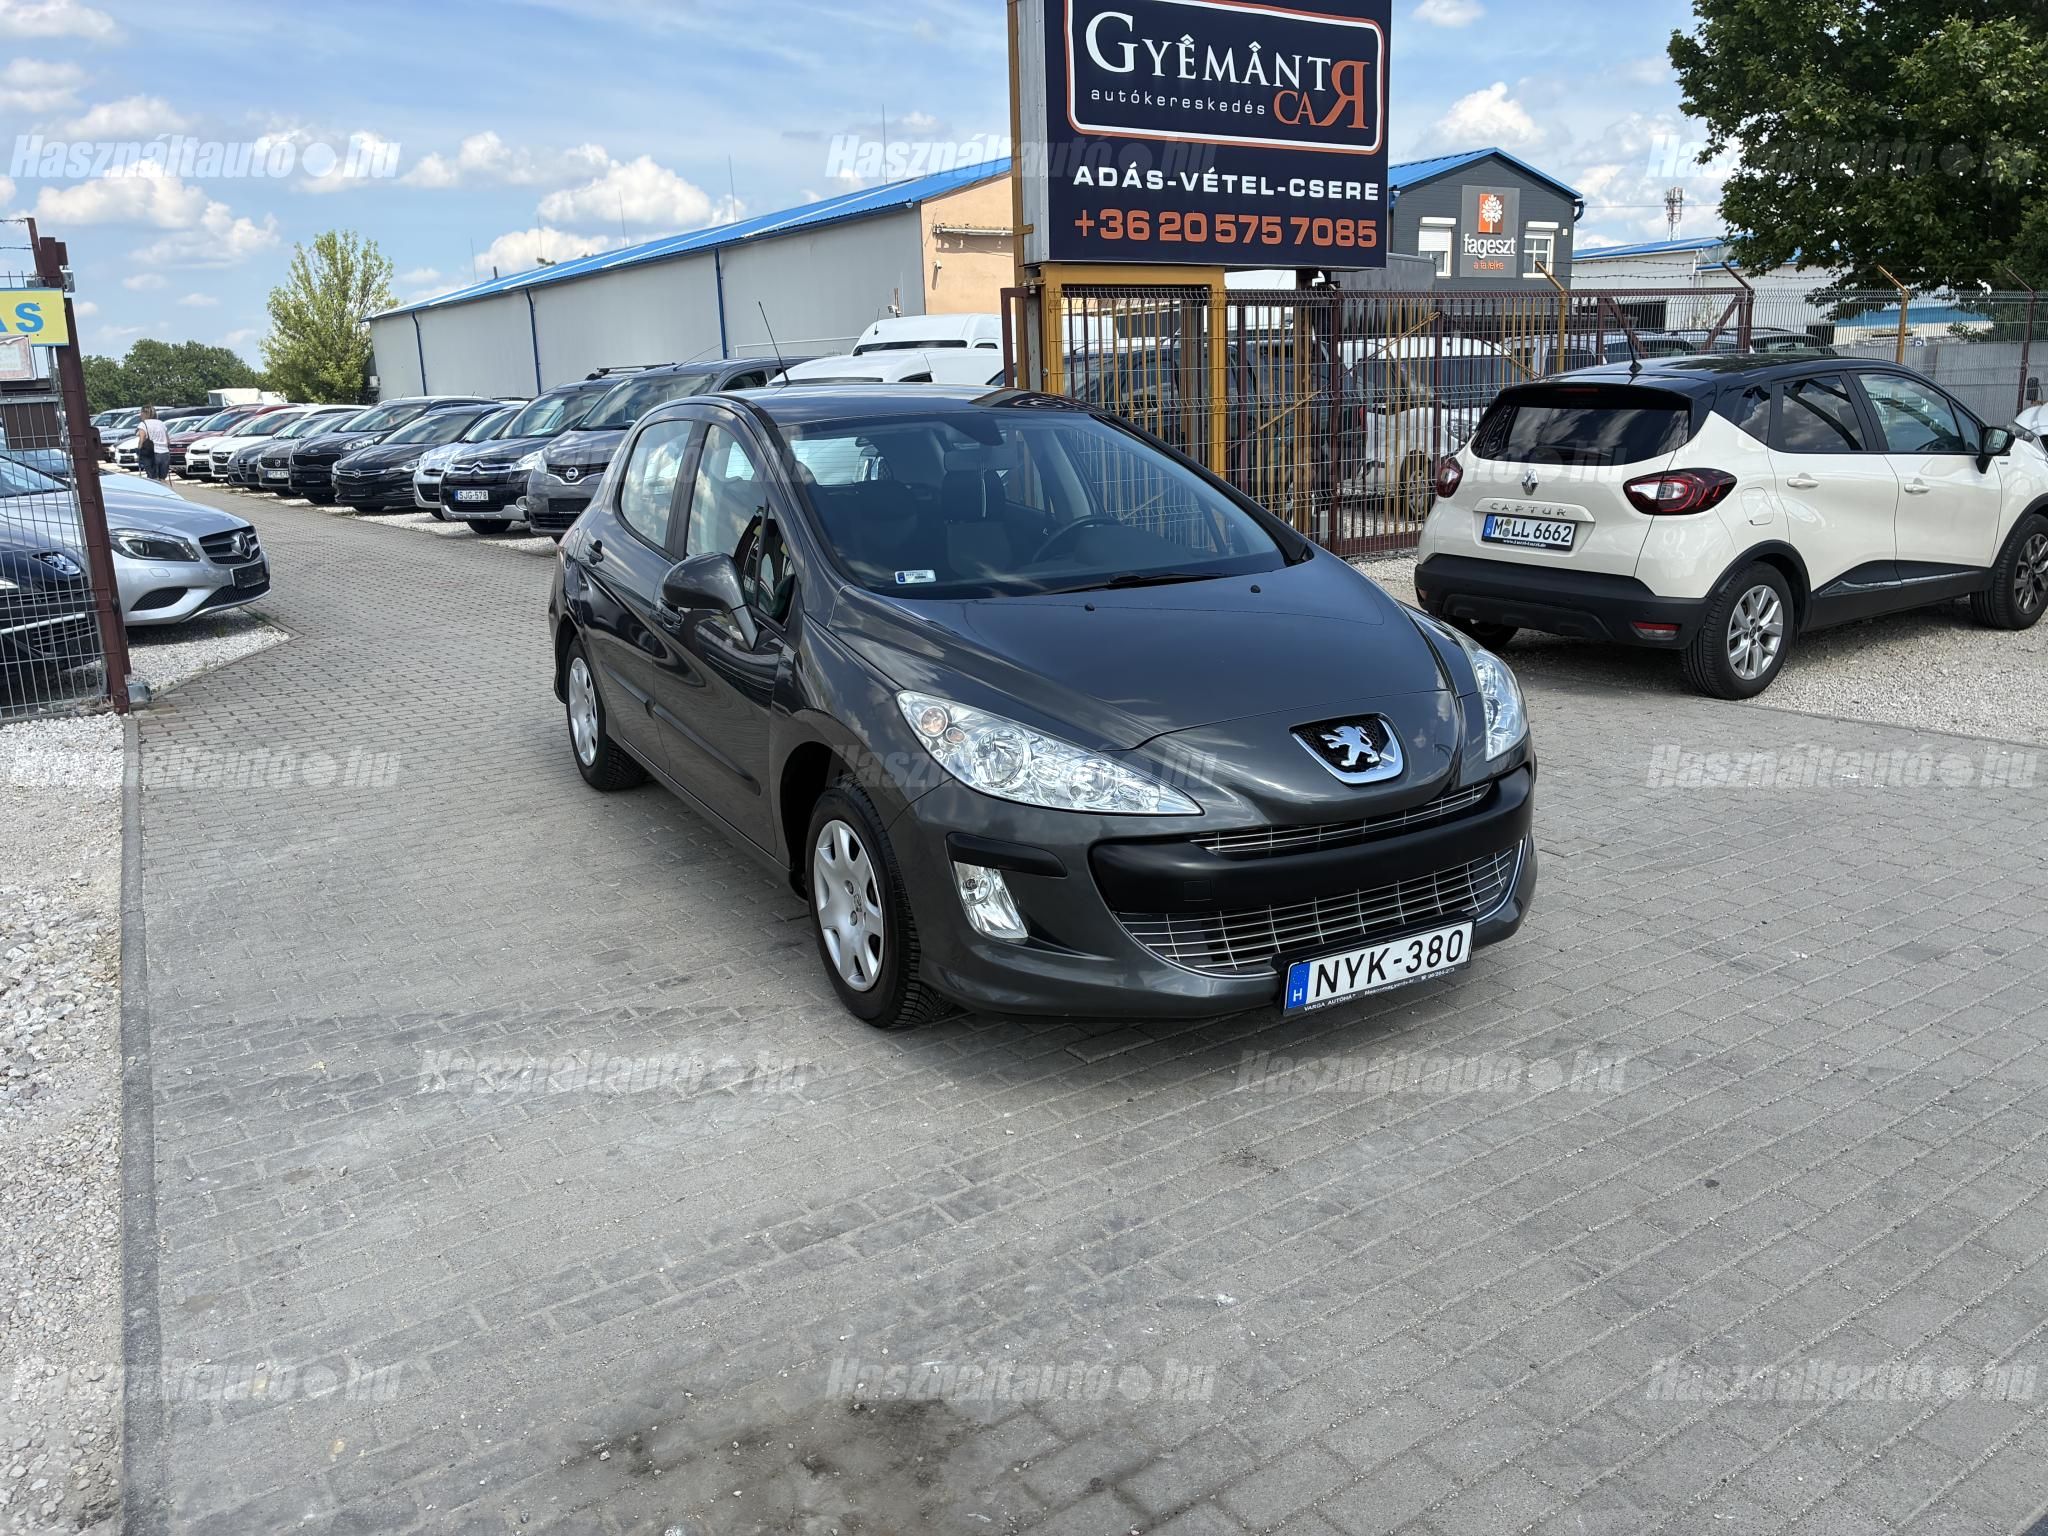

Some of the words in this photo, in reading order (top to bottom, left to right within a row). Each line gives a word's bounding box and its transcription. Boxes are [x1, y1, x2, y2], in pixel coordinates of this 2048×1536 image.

[1091, 88, 1265, 115] autókereskedés
[1073, 161, 1379, 200] ADÁS-VÉTEL-CSERE
[1075, 209, 1150, 241] +36
[1159, 211, 1207, 243] 20
[1215, 214, 1282, 245] 575
[1291, 217, 1377, 248] 7085
[1463, 233, 1516, 258] fageszt
[0, 302, 44, 333] S
[1490, 502, 1567, 516] CAPTUR
[1493, 518, 1505, 536] M
[1511, 520, 1530, 538] LL
[1533, 523, 1572, 543] 6662
[1315, 929, 1464, 998] NYK-380
